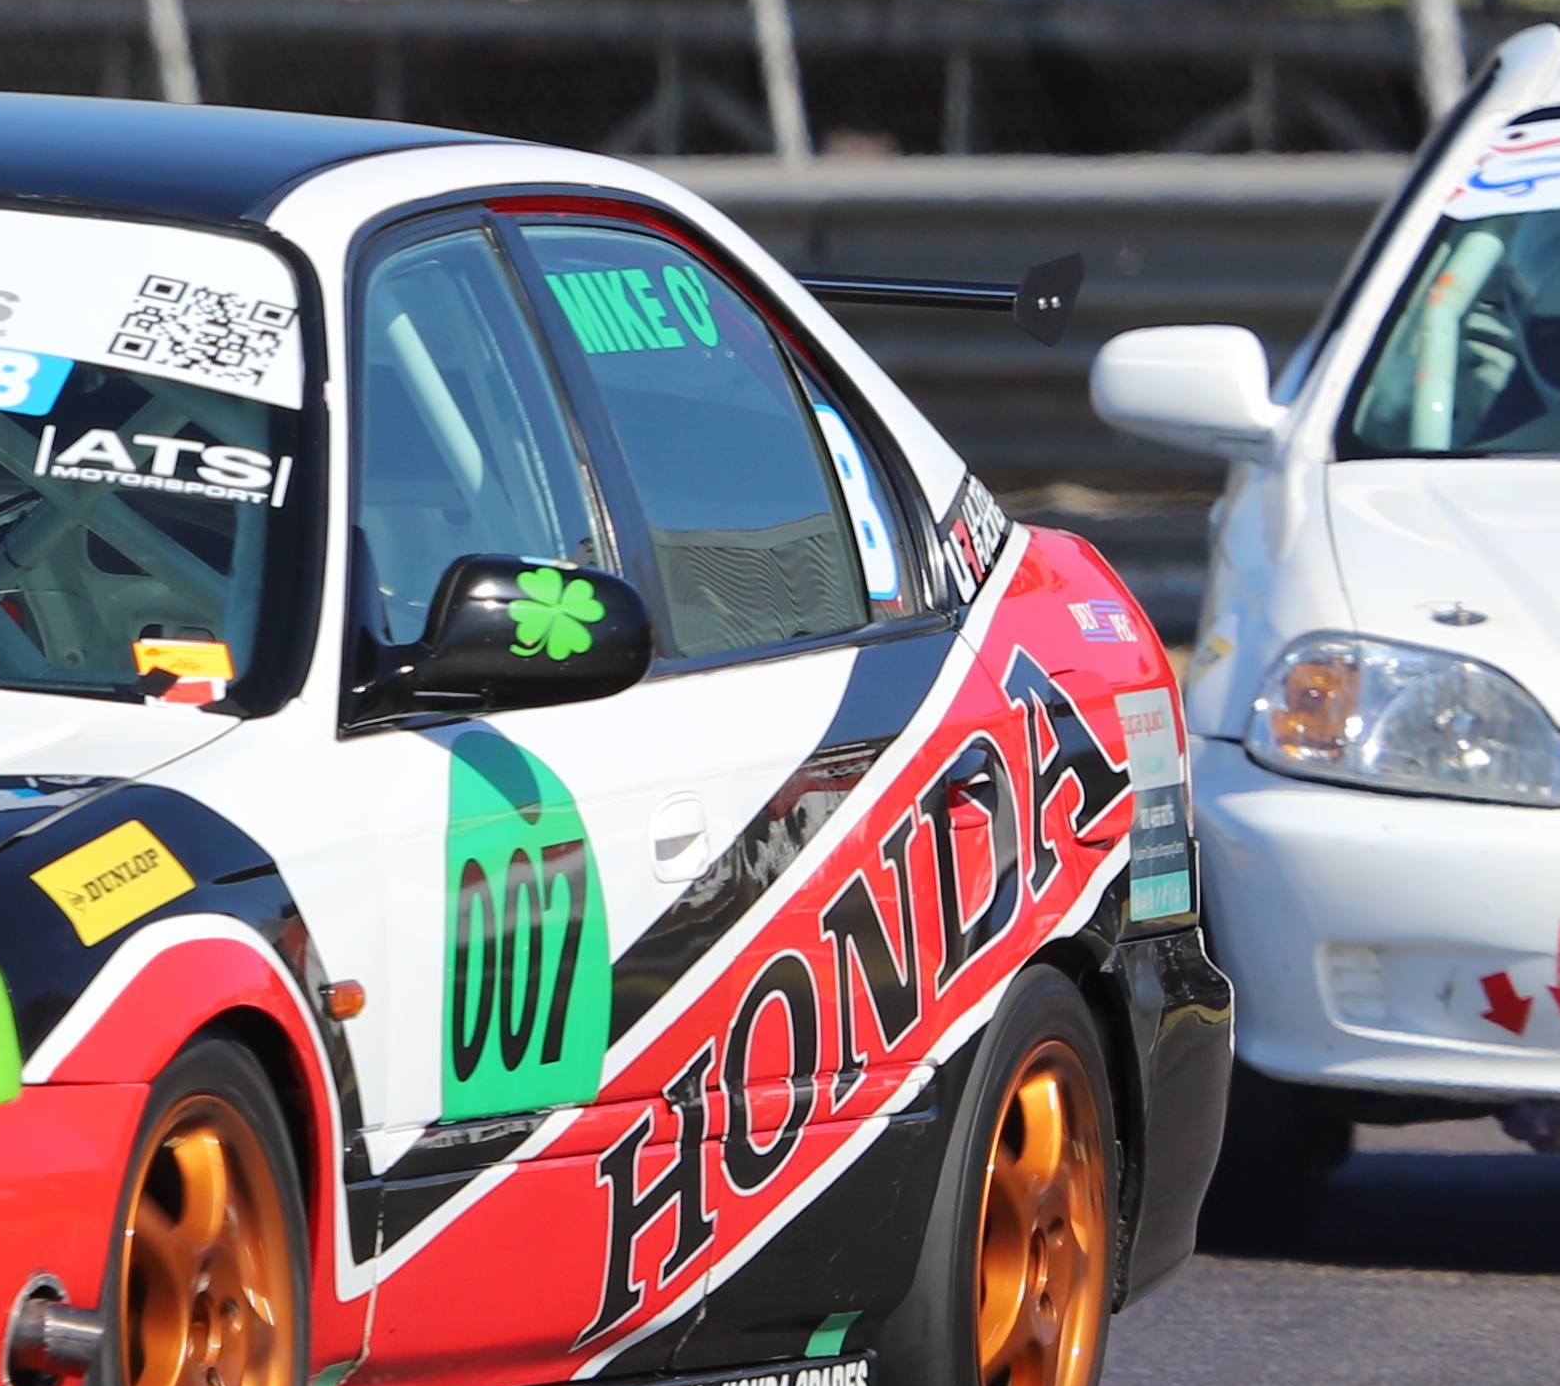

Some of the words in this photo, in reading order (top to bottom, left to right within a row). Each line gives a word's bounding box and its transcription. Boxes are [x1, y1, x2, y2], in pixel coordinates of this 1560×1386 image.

[543, 268, 687, 355] MIKE
[51, 464, 269, 505] MOTORSPORT
[53, 428, 274, 490] ATS
[81, 846, 162, 903] DUNLOP
[451, 839, 586, 1083] 007
[572, 643, 1132, 1353] HONDA
